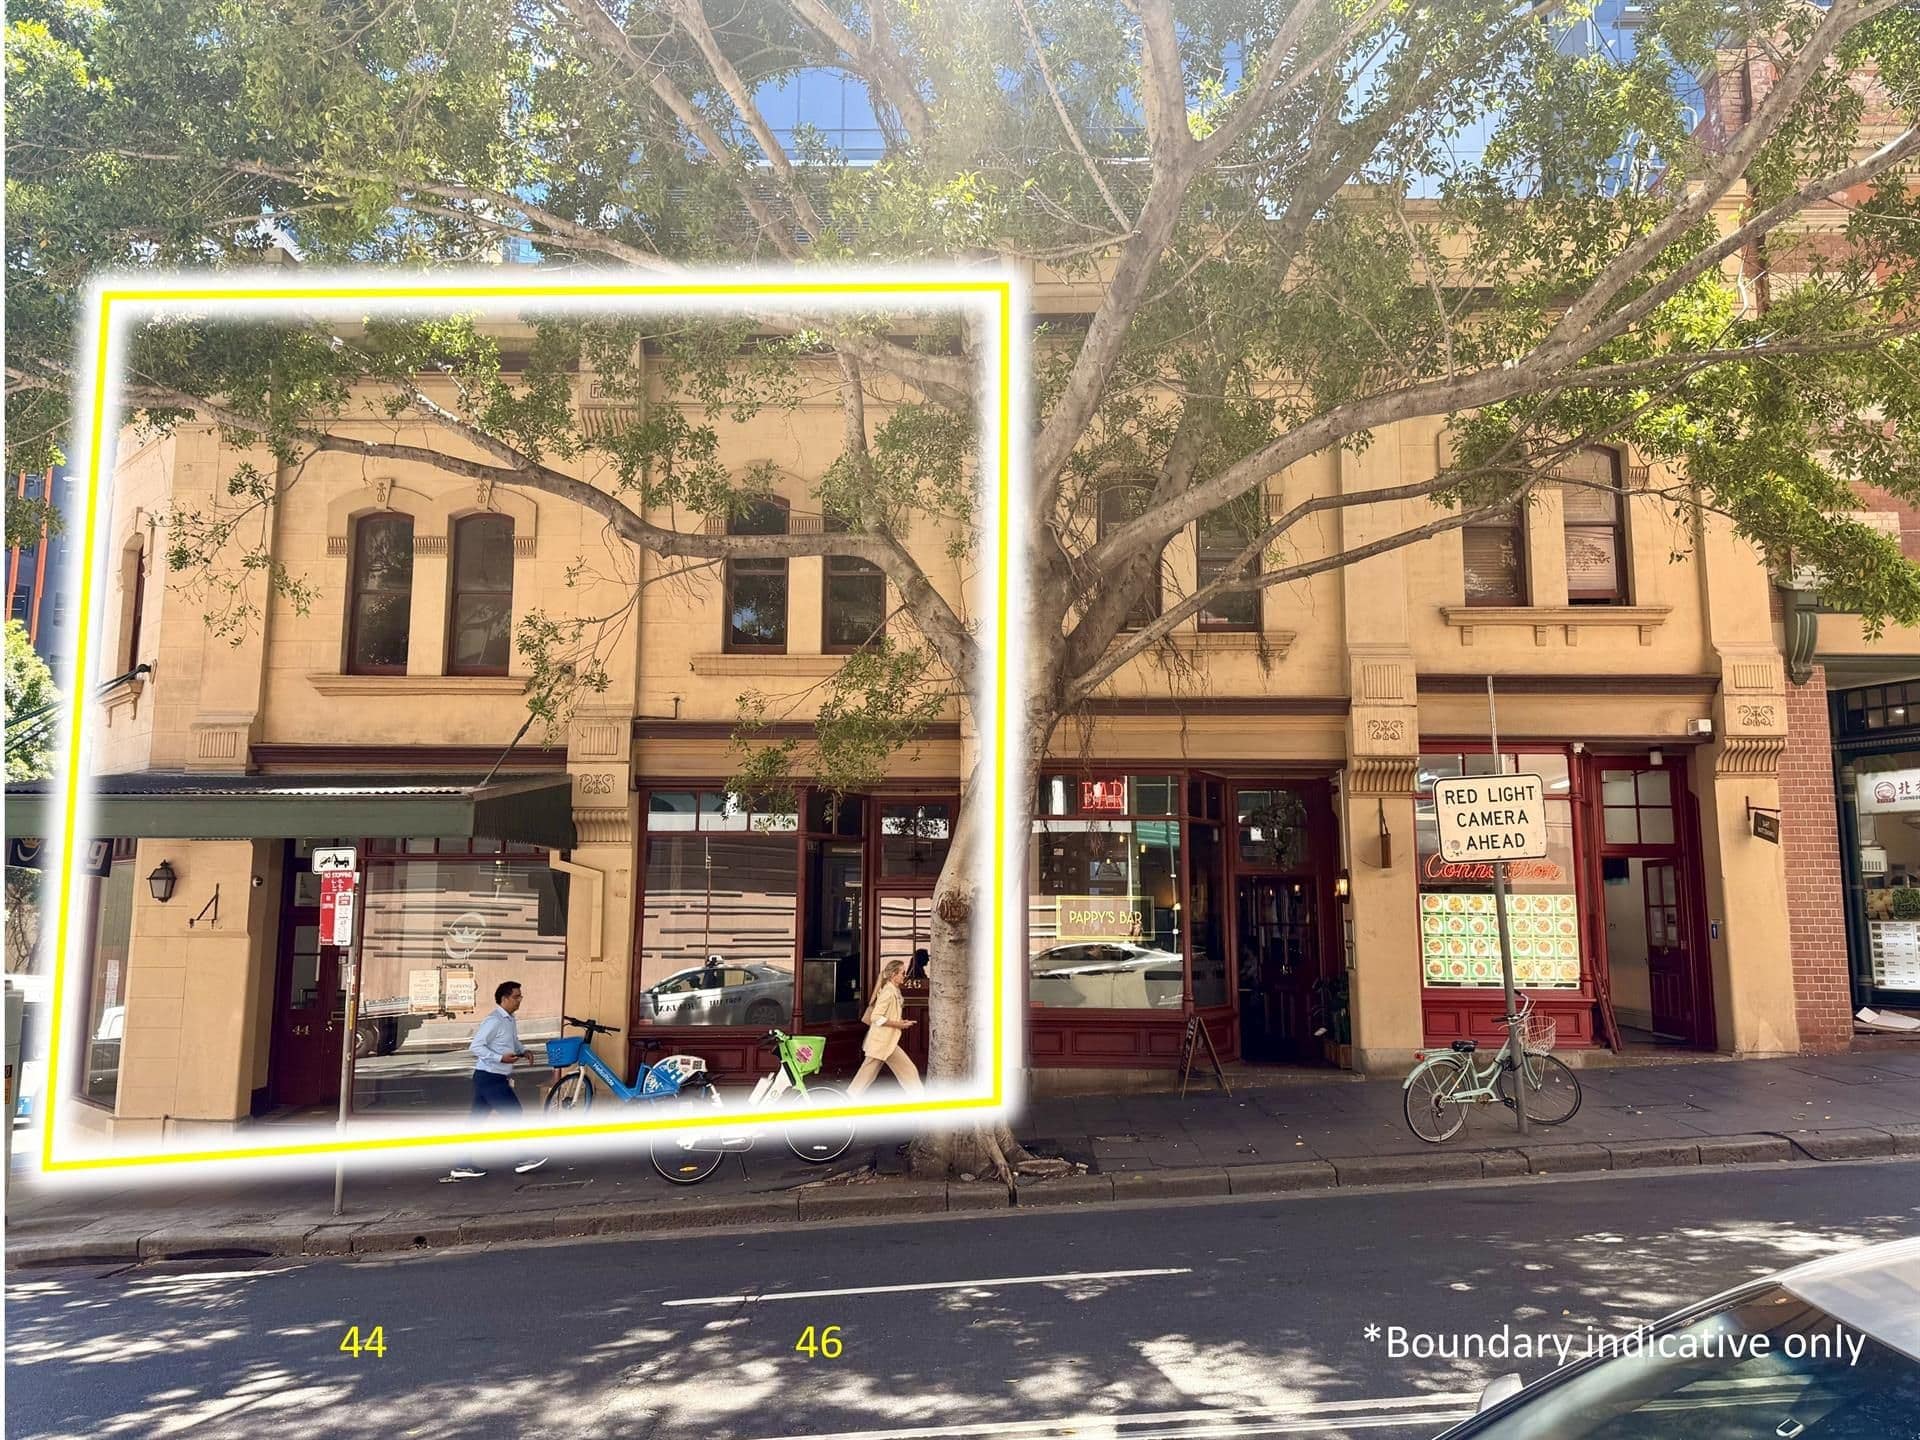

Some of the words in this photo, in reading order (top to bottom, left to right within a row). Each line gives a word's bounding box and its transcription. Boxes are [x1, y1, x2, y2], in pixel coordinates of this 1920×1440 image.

[1445, 788, 1478, 805] RED
[1488, 785, 1535, 803] LIGHT
[1456, 809, 1529, 827] CAMERA
[1466, 832, 1526, 851] AHEAD
[1069, 910, 1116, 924] PAPPY'S
[1119, 911, 1143, 924] BAR
[904, 979, 922, 989] 46
